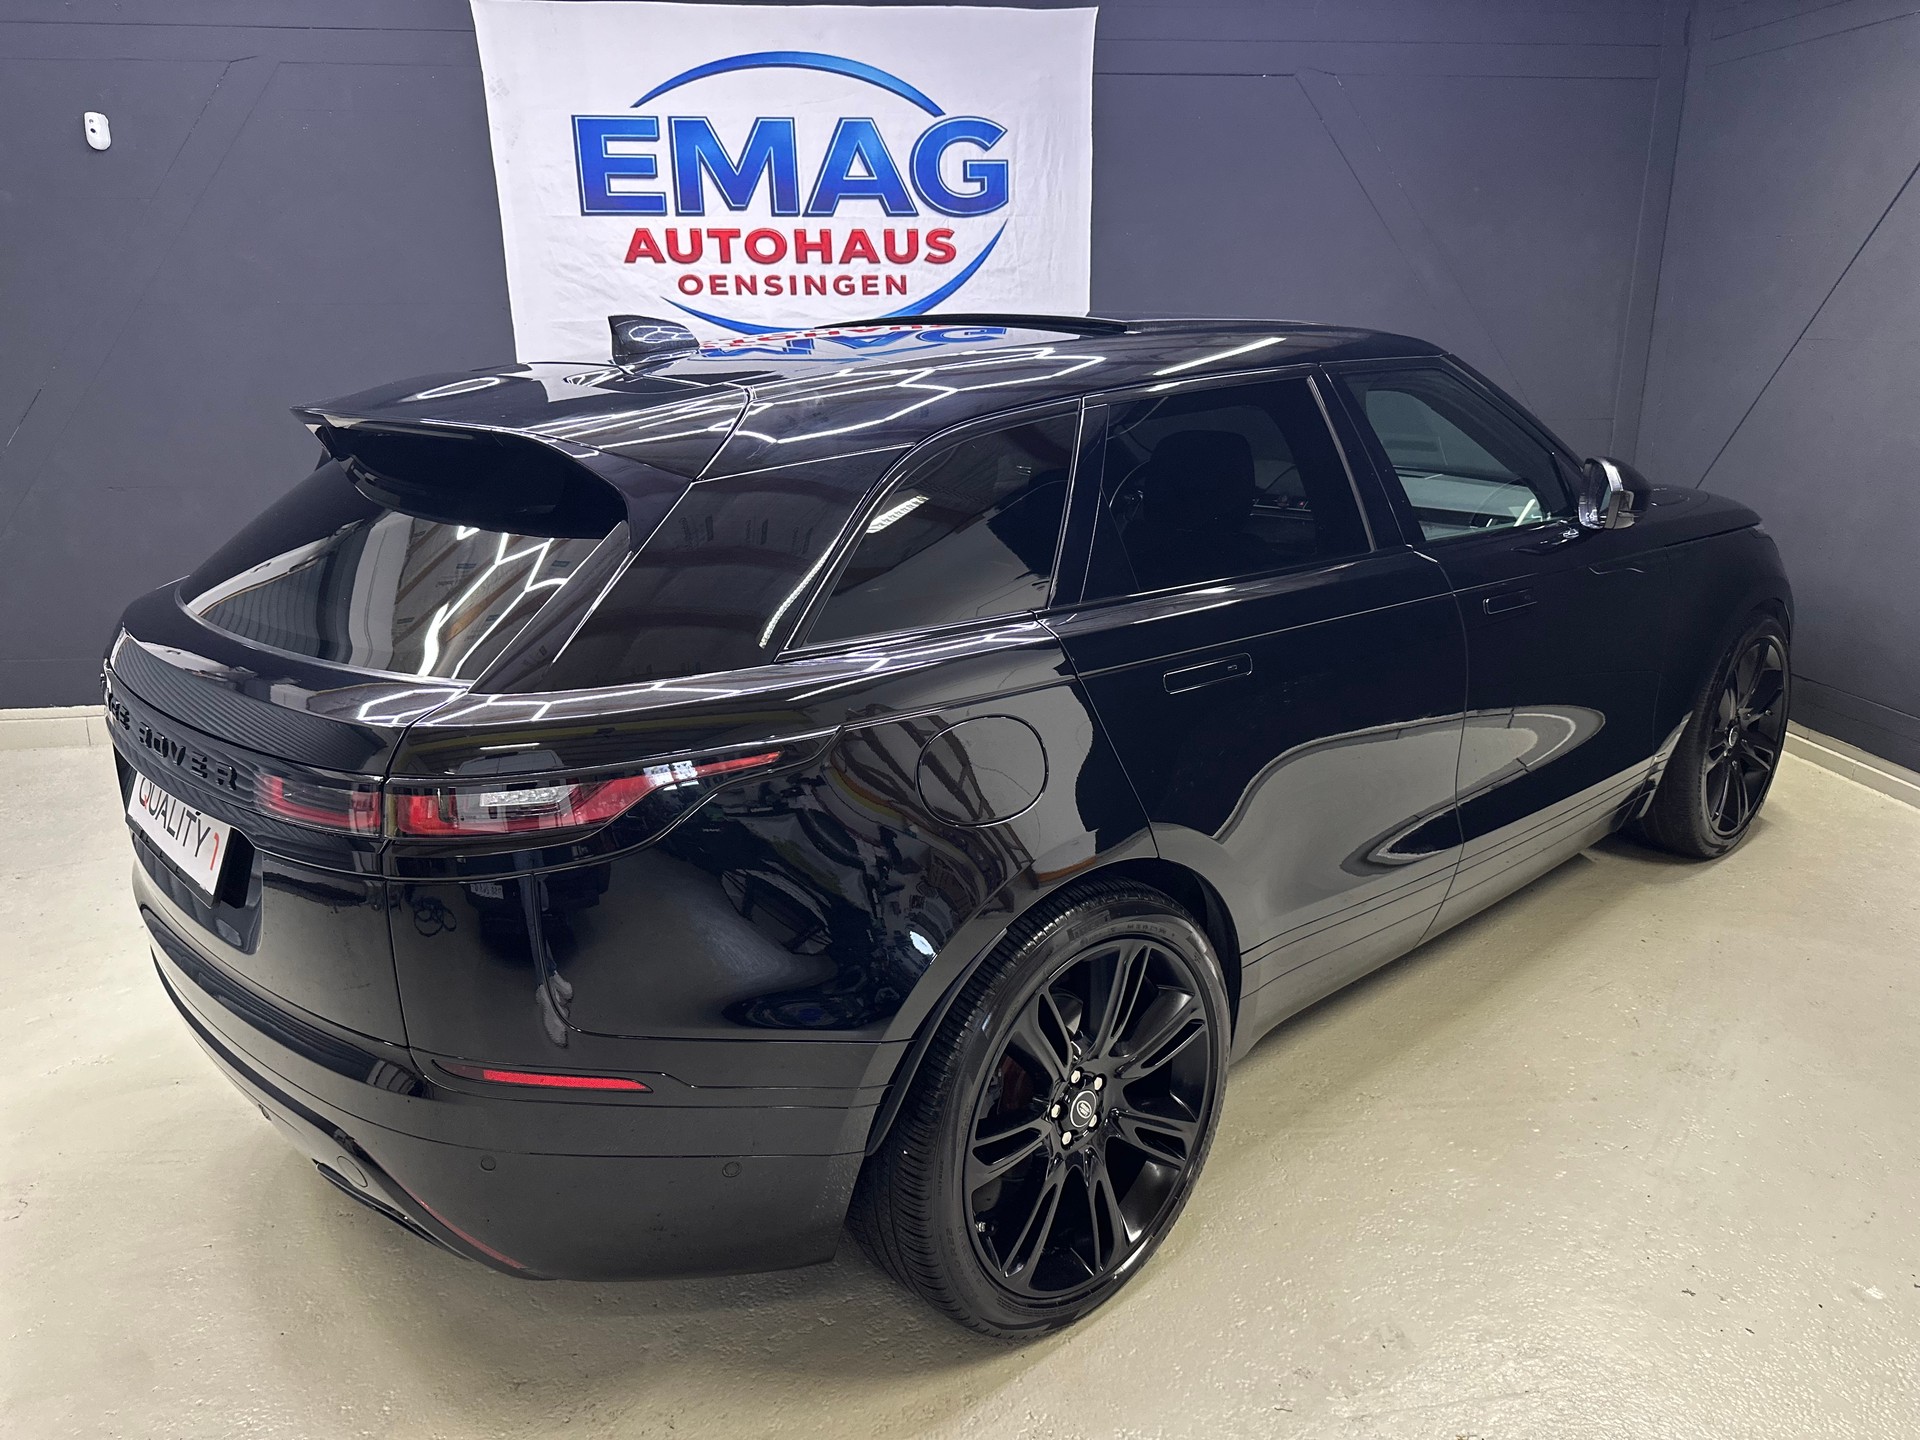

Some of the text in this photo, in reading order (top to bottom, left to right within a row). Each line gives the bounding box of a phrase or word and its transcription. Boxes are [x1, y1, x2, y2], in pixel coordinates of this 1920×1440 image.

[571, 115, 1009, 218] EMAG
[624, 227, 956, 264] AUTOHAUS
[677, 274, 908, 296] OENSINGEN
[138, 777, 219, 871] QUALITY 1
